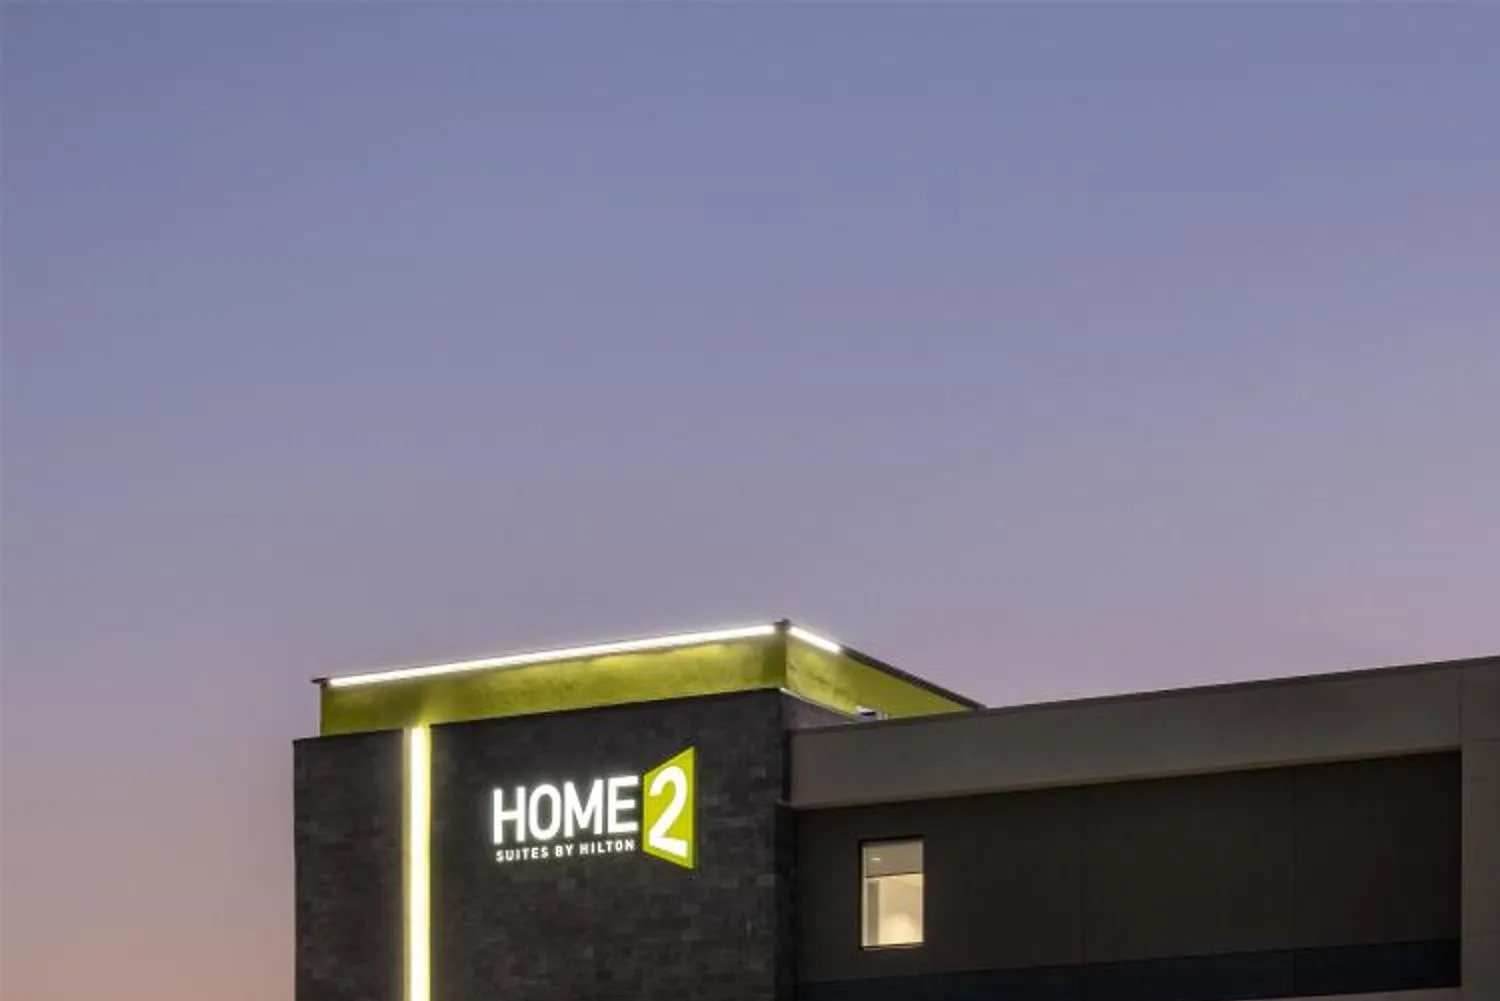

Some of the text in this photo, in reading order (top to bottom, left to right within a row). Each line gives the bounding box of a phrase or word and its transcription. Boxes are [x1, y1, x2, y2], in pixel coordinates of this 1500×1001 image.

[493, 765, 688, 857] HOME 2
[496, 839, 637, 862] SUITES BY HILTON
